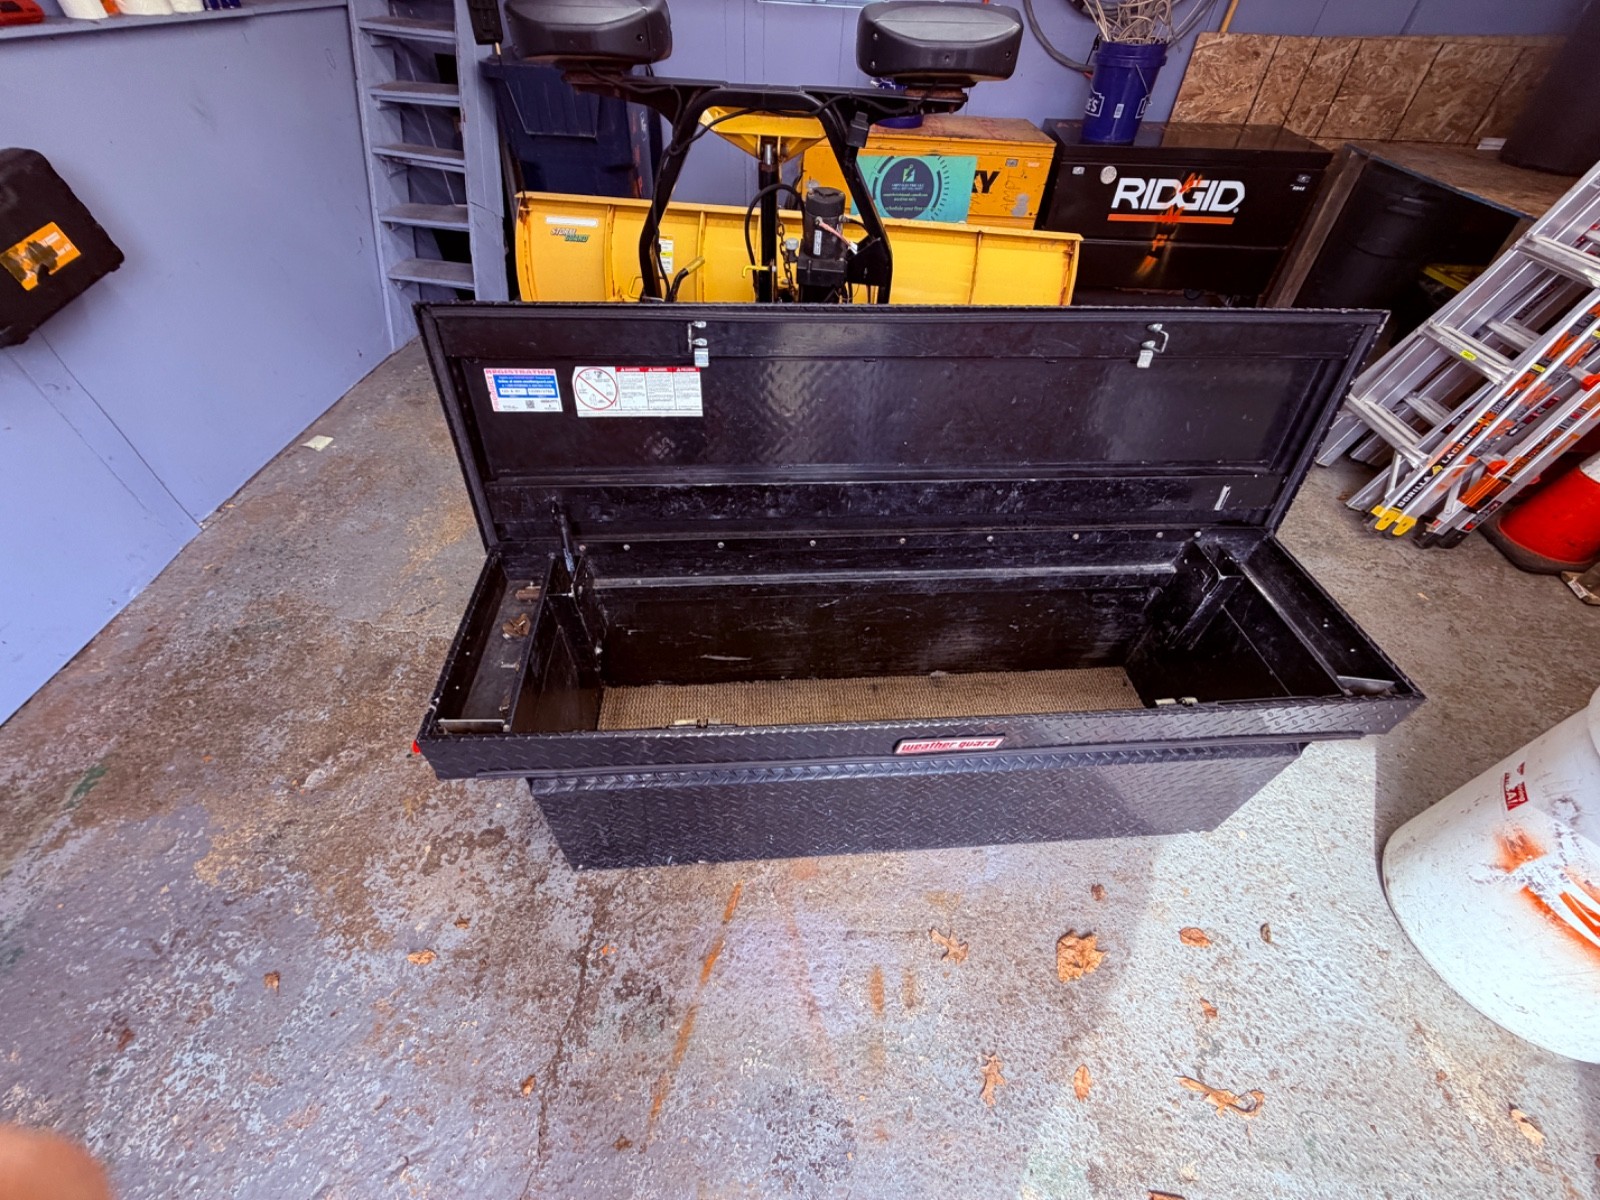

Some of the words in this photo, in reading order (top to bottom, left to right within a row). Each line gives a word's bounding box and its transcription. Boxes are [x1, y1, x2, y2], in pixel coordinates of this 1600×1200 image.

[1111, 177, 1246, 213] RIDGID
[901, 742, 957, 752] weather
[958, 740, 998, 750] guard
